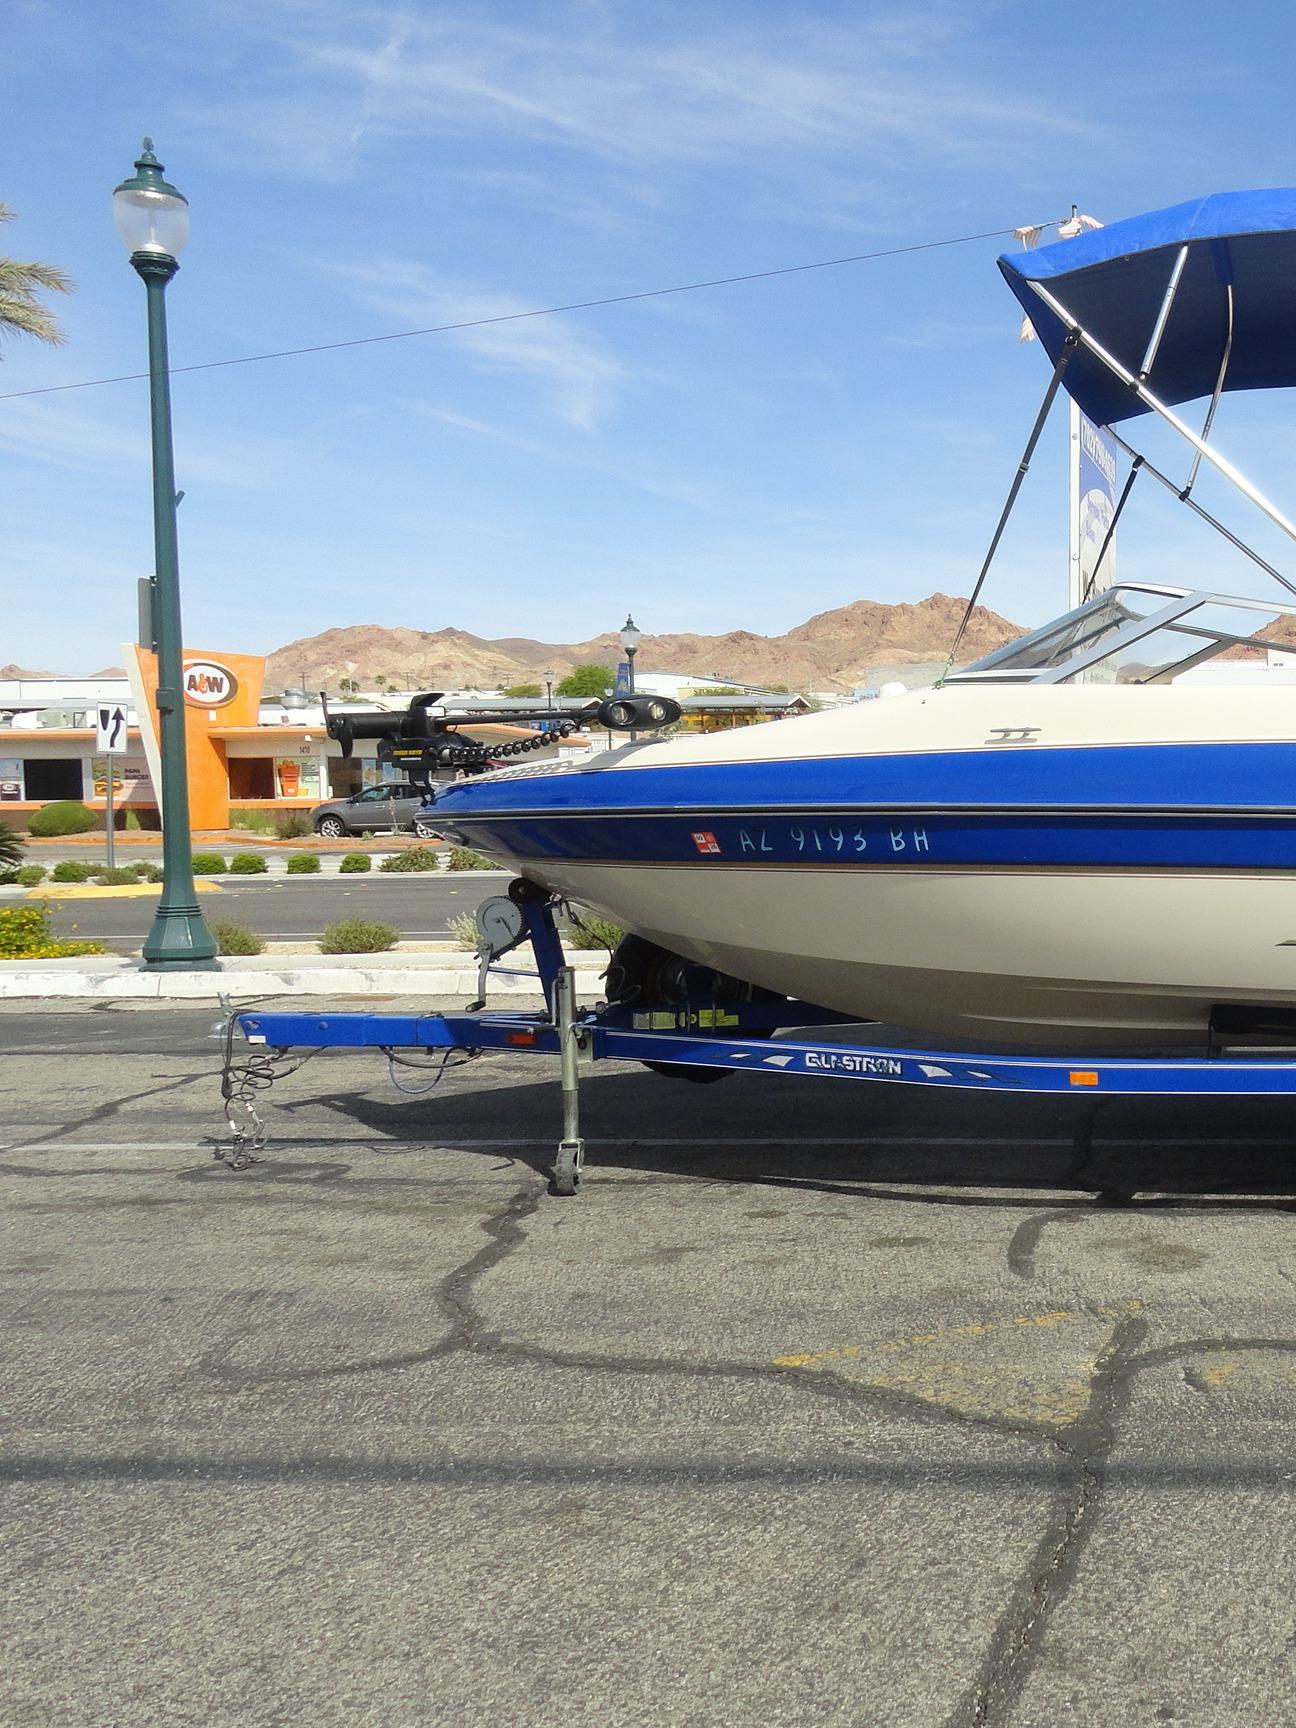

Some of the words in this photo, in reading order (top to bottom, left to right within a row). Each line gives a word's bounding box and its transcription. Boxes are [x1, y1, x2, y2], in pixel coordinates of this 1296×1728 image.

[187, 673, 224, 694] A&W
[790, 824, 867, 851] 9193
[889, 825, 929, 851] BH
